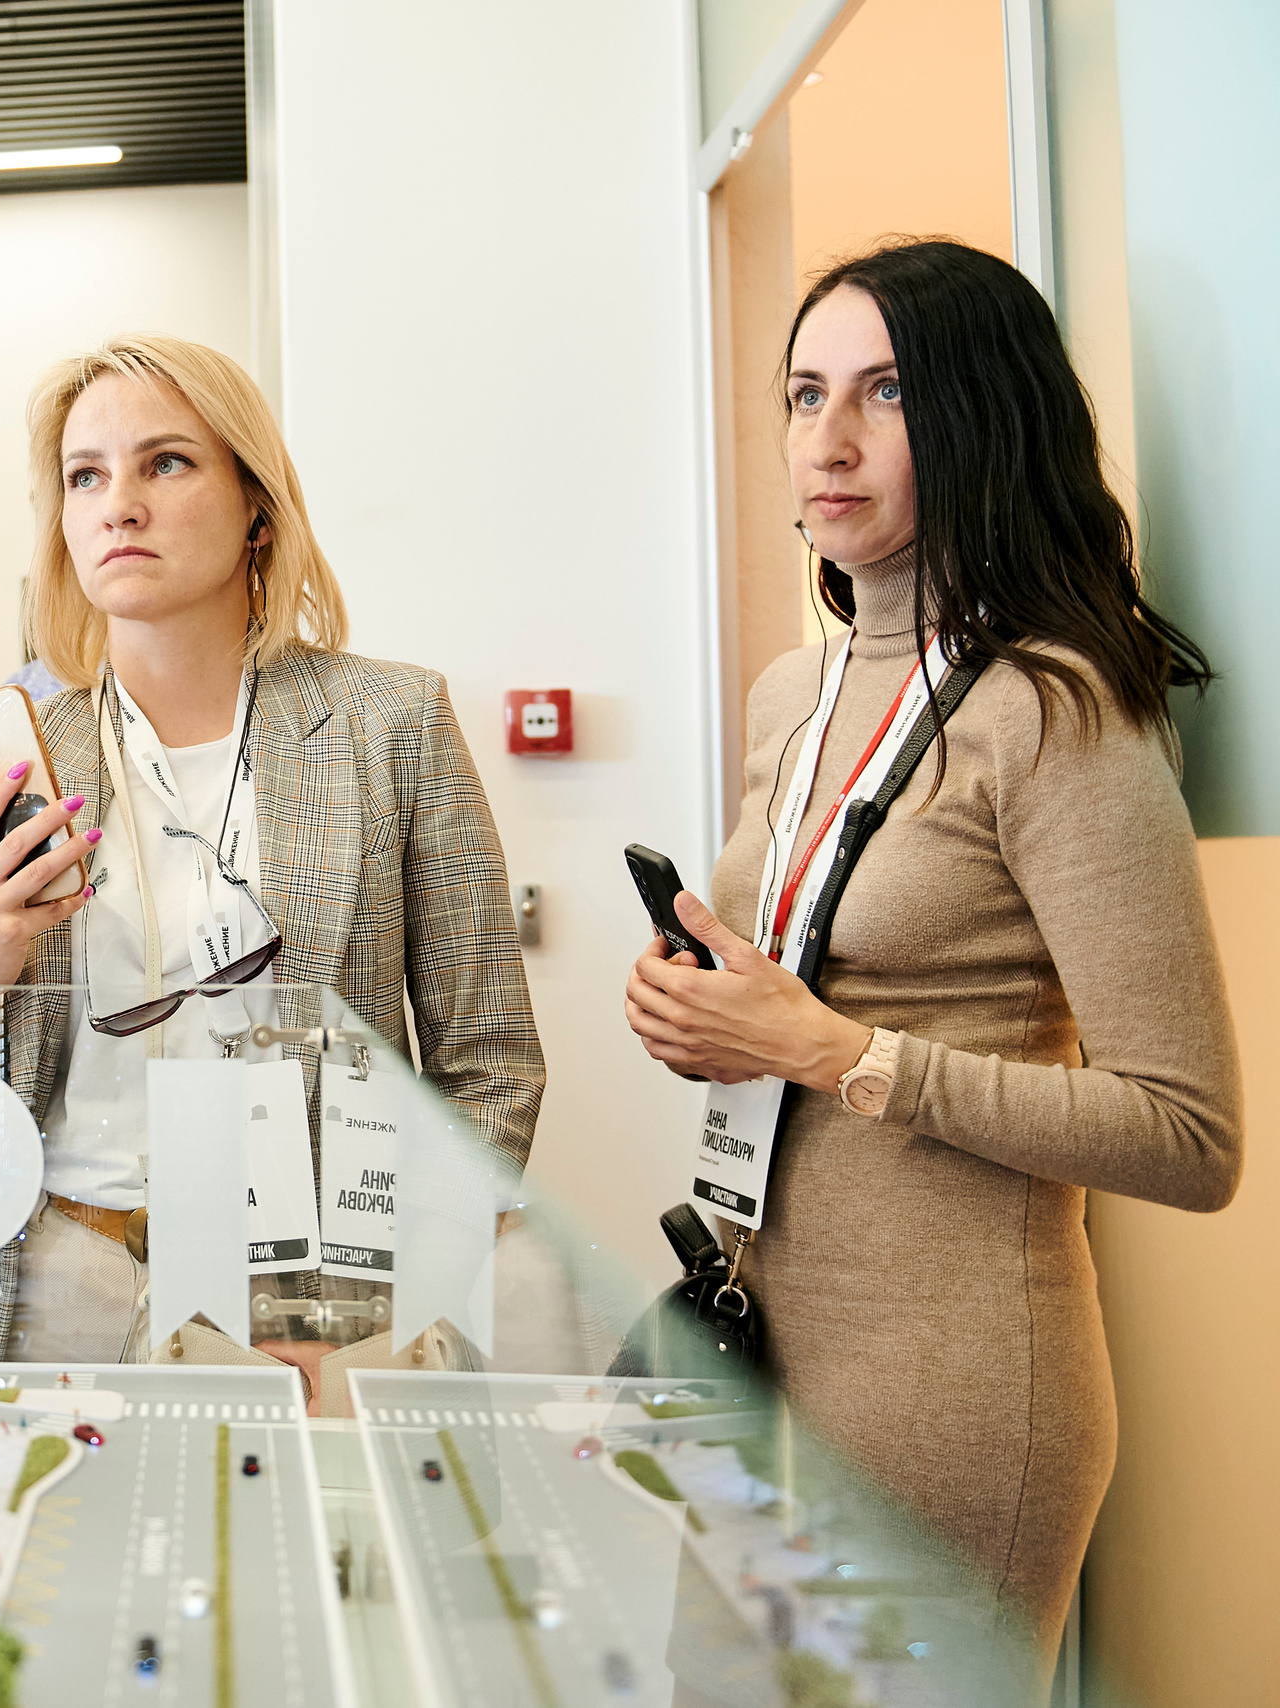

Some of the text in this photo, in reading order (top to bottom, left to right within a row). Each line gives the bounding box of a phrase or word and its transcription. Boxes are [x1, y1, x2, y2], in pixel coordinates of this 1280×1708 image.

[706, 1108, 728, 1131] АННА
[702, 1128, 755, 1163] ПИЦХЕЛАУРИ
[709, 1185, 739, 1208] УЧАСТНИК
[248, 1243, 276, 1260] ТНИК
